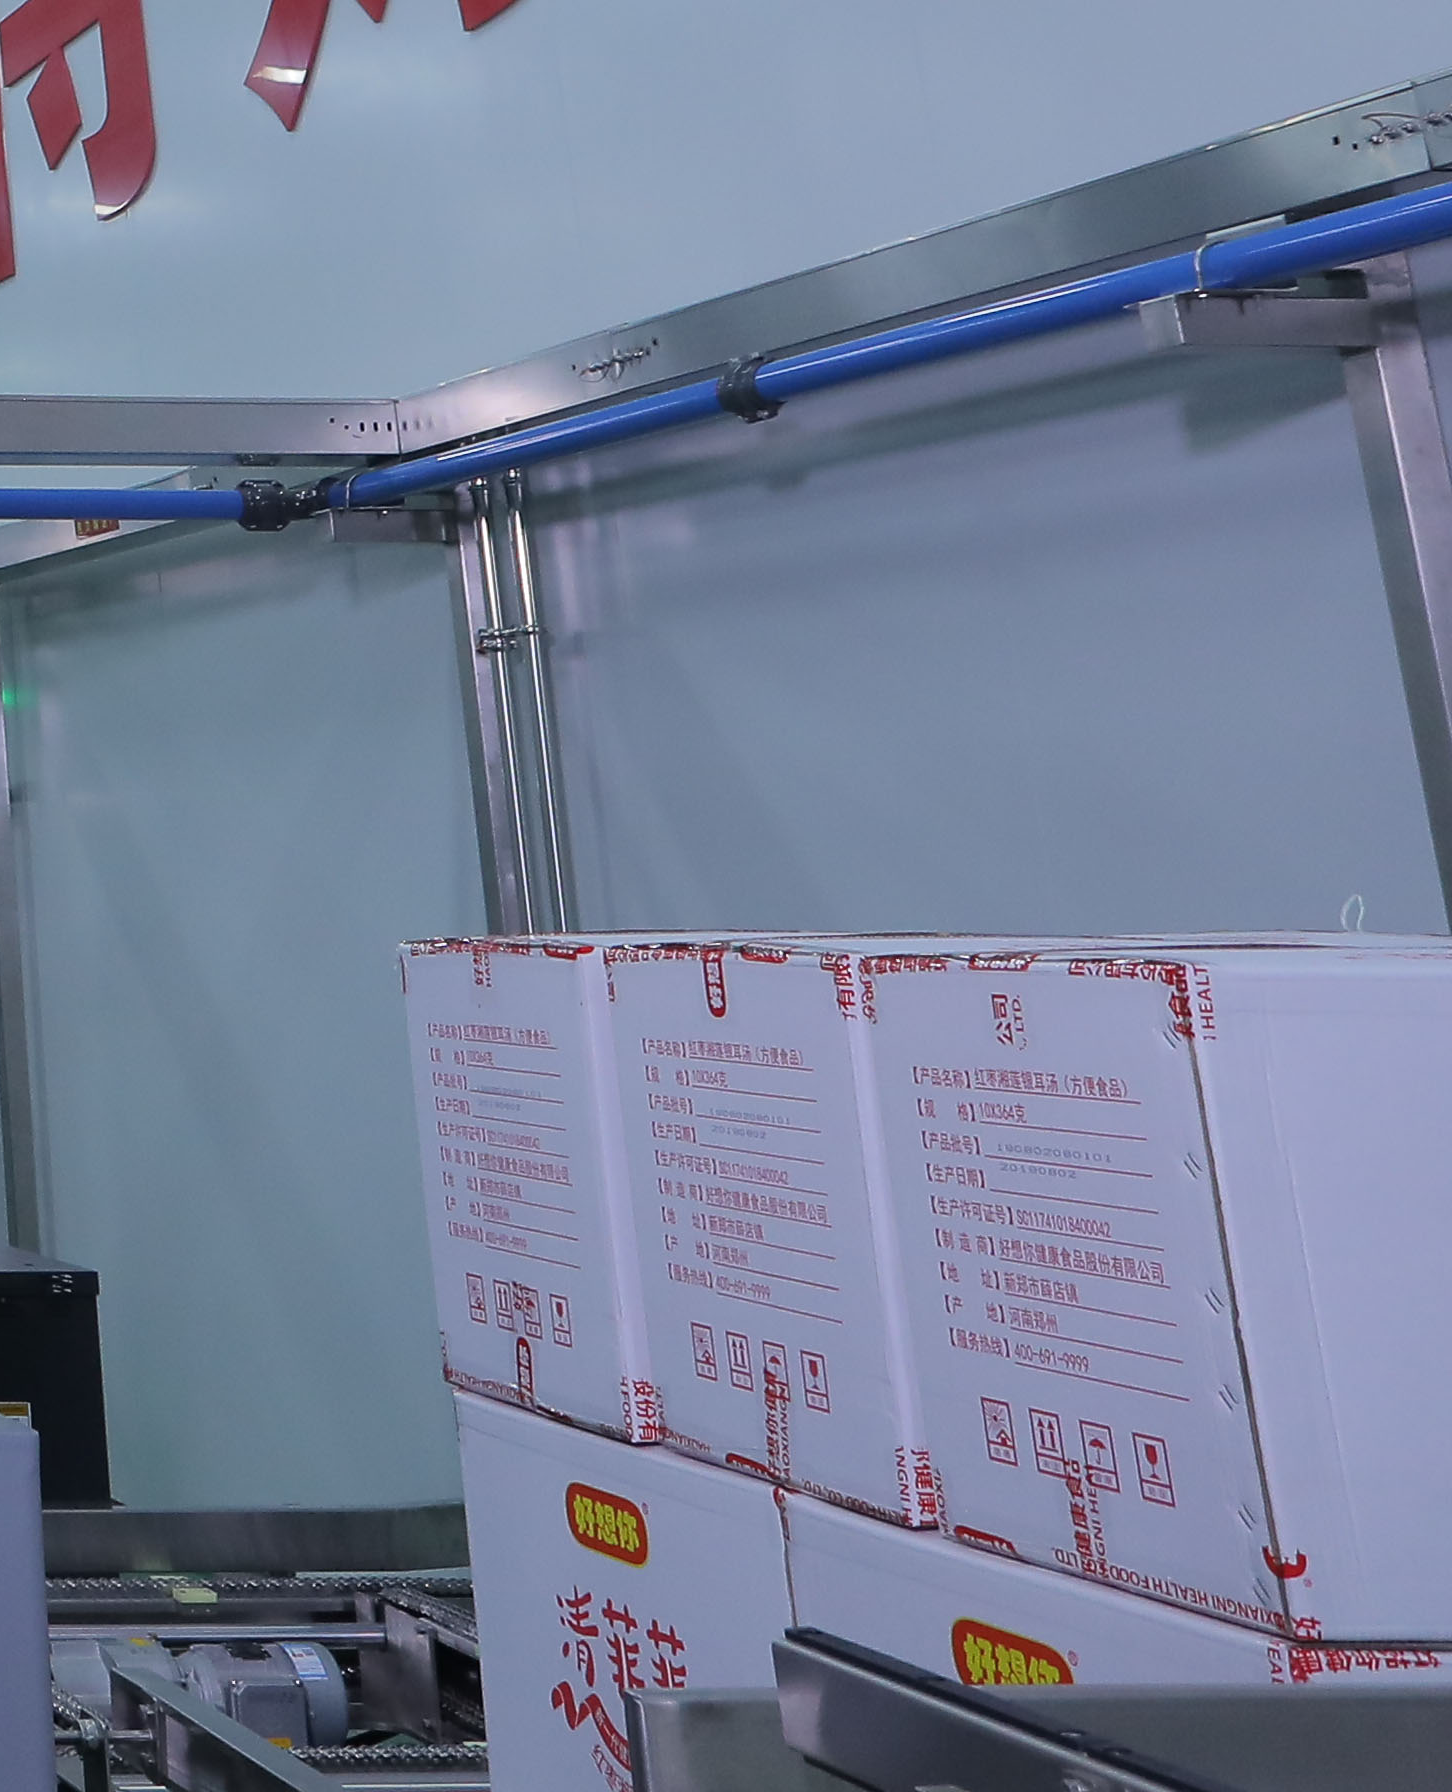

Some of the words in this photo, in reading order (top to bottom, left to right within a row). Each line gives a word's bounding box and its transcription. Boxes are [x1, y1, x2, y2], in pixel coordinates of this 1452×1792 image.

[991, 994, 1015, 1046] 公司
[642, 1038, 686, 1058] 【产品名称】
[912, 1066, 971, 1089] 【产品名称】
[922, 1130, 981, 1155] 【产品批号】
[926, 1163, 985, 1189] 【生产日期】
[930, 1195, 1014, 1225] 【生产许可证号】
[998, 1237, 1165, 1284] 好想你健康食品股份有限公司
[949, 1327, 1010, 1358] 【服务热线】
[1014, 1342, 1089, 1373] 400-691-9999
[573, 1493, 641, 1553] 好想你
[1109, 1562, 1151, 1592] FOOD
[1153, 1575, 1209, 1607] HEALTH
